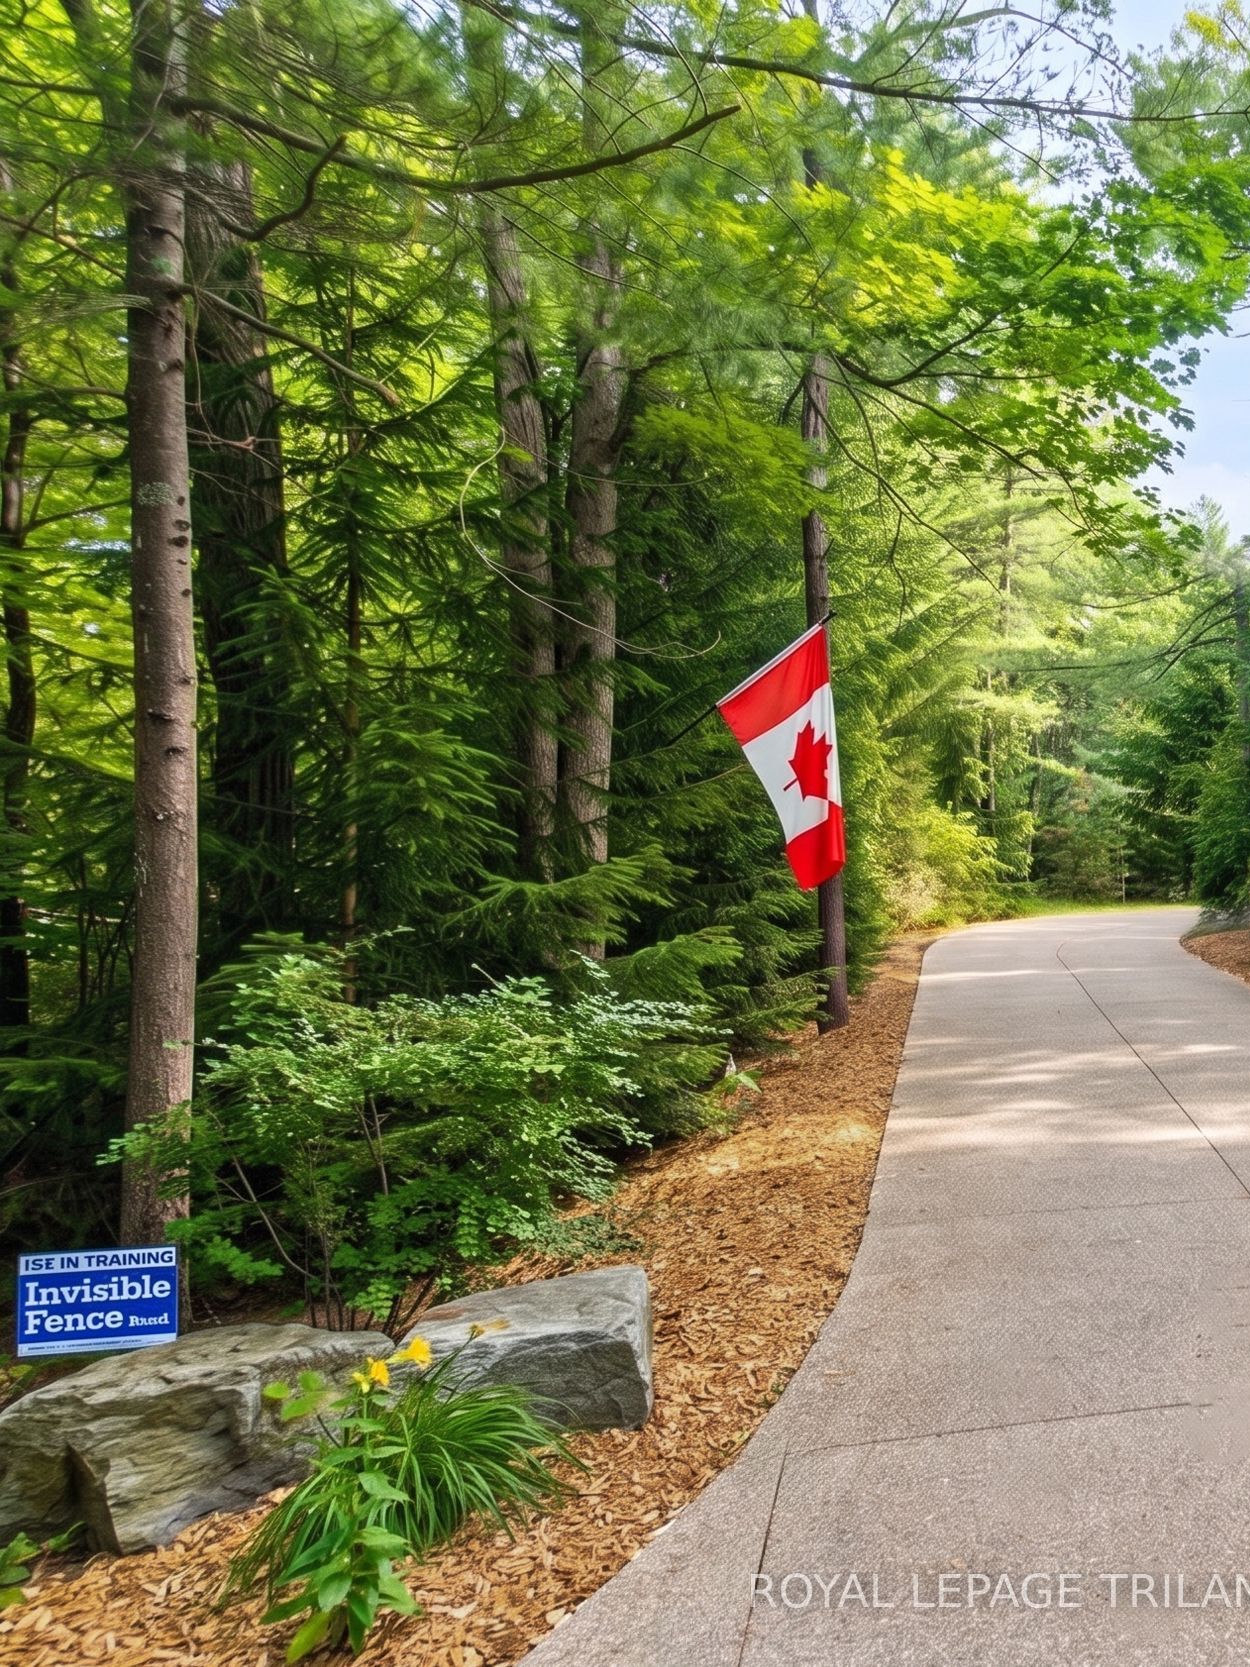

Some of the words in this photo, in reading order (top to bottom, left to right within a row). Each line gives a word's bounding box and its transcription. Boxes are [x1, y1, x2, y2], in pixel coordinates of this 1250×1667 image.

[60, 1256, 79, 1269] IN
[84, 1250, 173, 1267] TRAINING
[25, 1275, 171, 1306] Invisible
[24, 1310, 123, 1335] Fence
